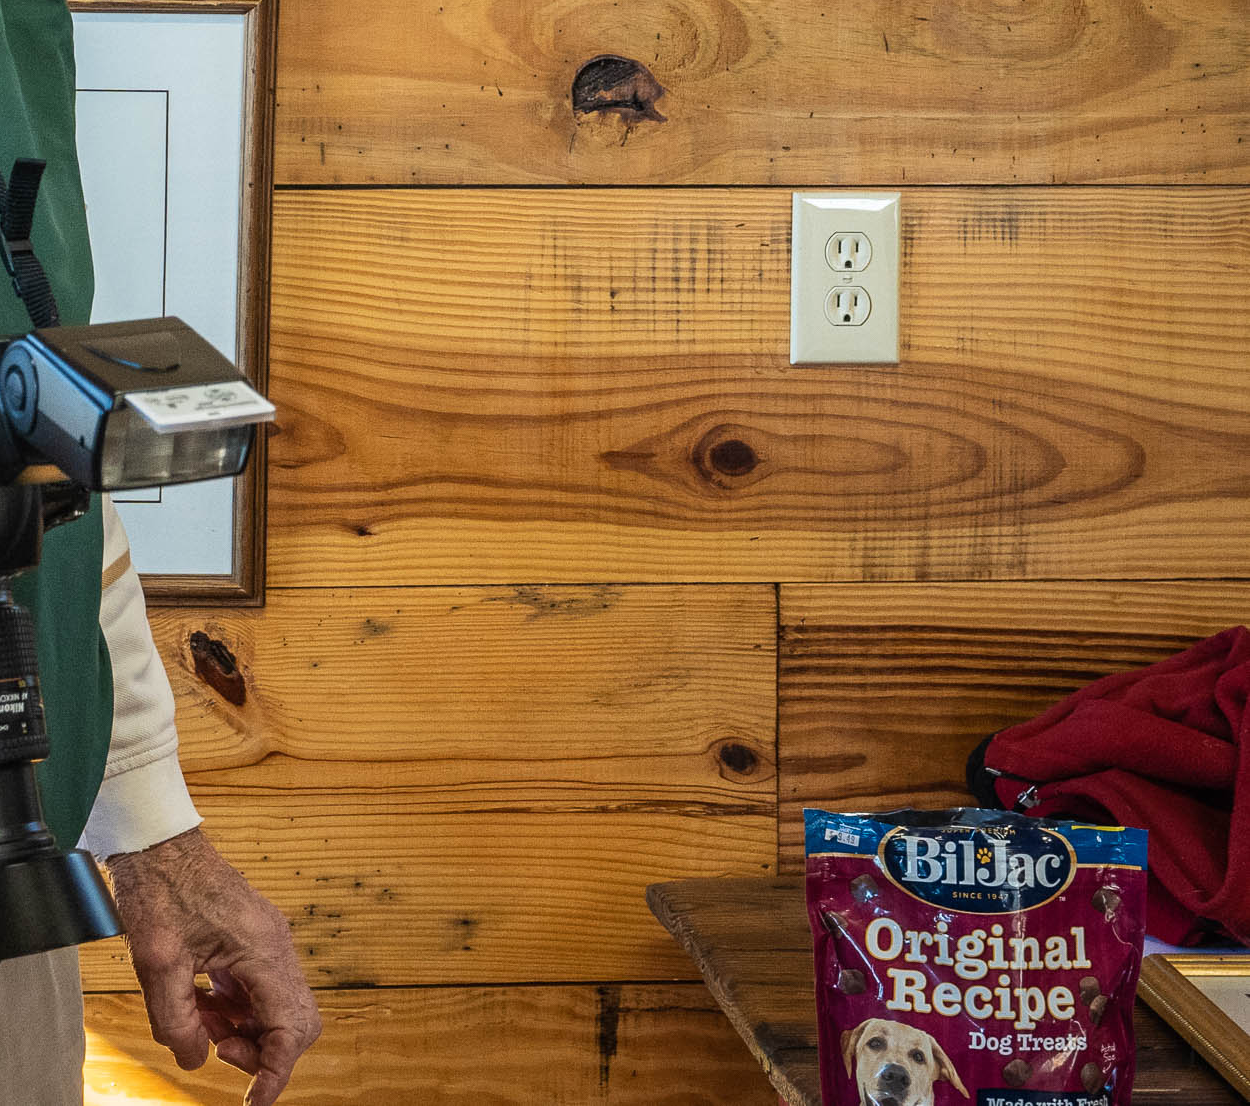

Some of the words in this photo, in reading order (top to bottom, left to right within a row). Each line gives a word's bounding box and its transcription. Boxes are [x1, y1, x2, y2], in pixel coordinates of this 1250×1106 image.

[951, 891, 983, 900] SINCE
[865, 917, 1092, 980] Original
[885, 967, 1076, 1031] Recipe
[968, 1031, 1013, 1055] Dog
[1017, 1033, 1088, 1052] Treats
[986, 1097, 1033, 1106] Made
[1036, 1097, 1073, 1106] with
